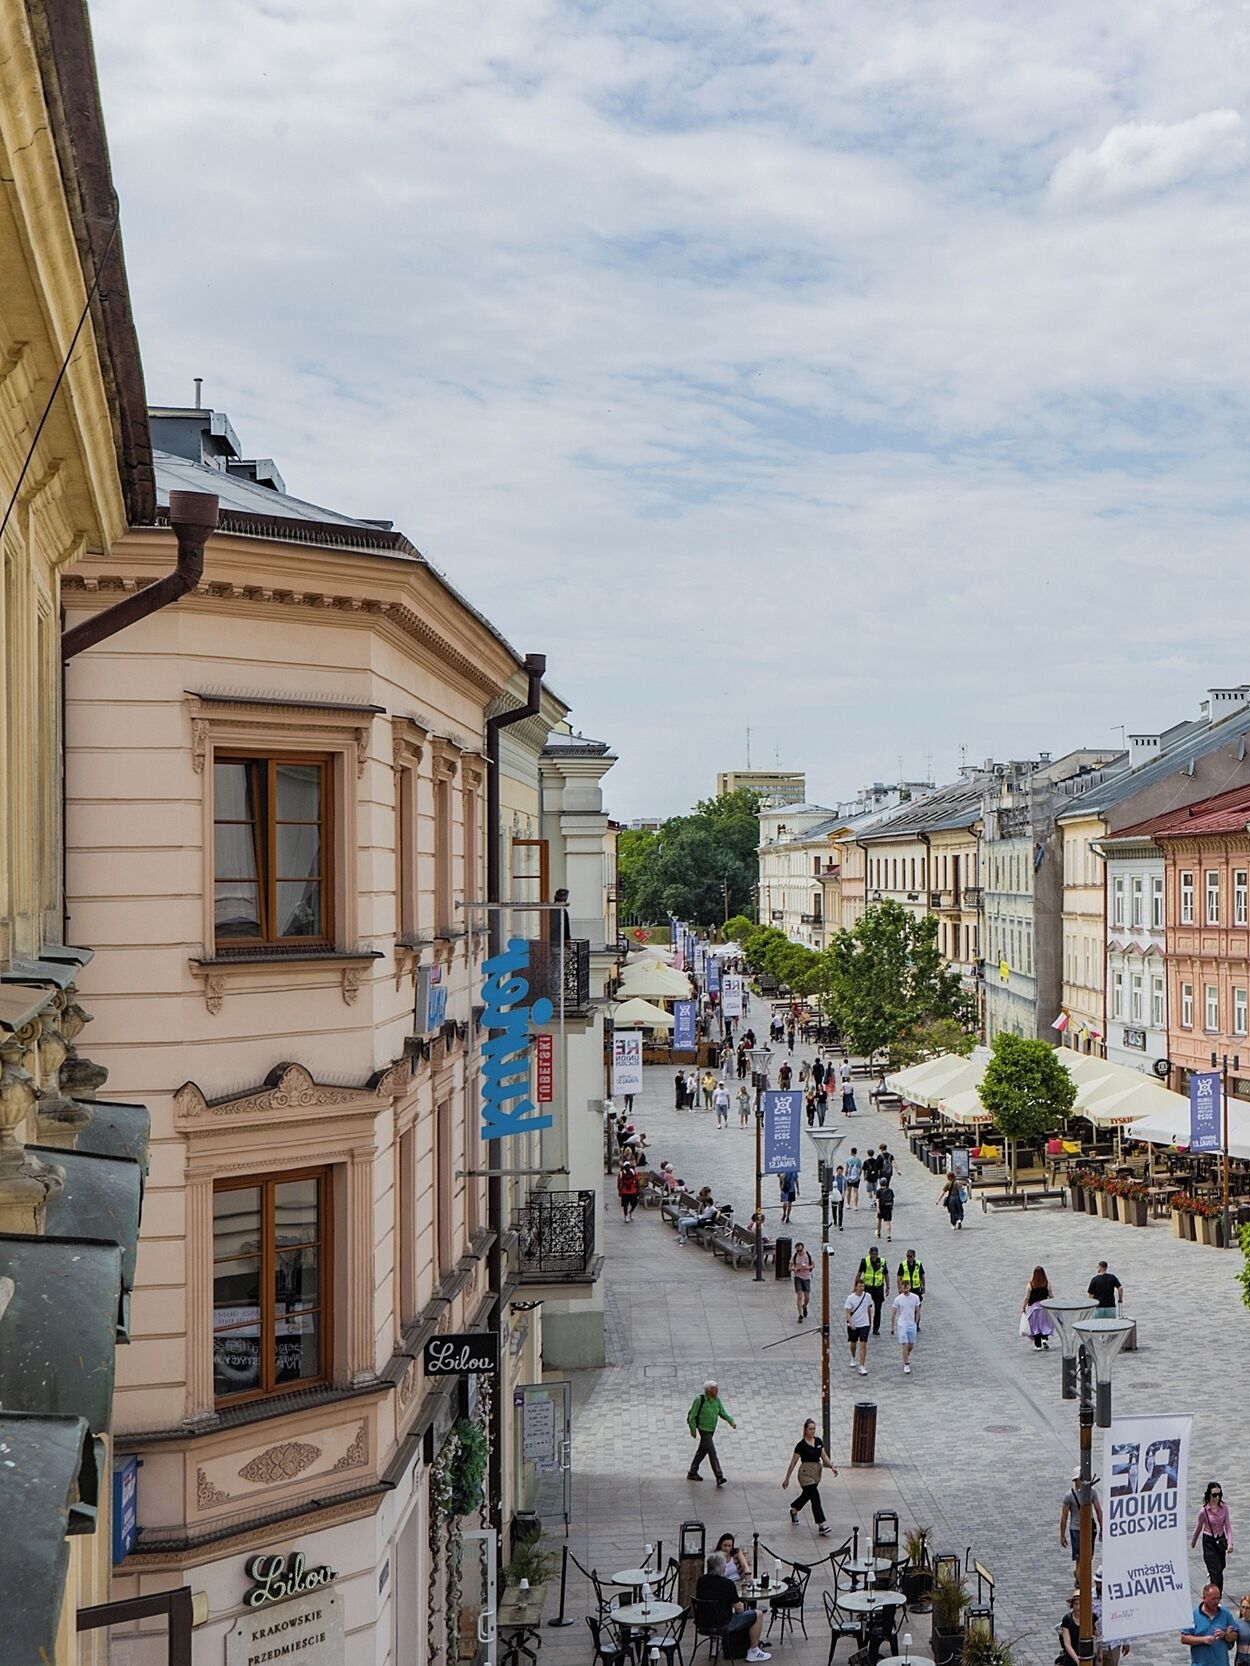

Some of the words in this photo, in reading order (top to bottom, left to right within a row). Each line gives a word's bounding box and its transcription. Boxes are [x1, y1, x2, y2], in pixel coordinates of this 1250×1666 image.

[429, 1341, 494, 1372] Lilou
[244, 1552, 339, 1607] Lilou
[252, 1610, 322, 1641] KRAKOWSKIE
